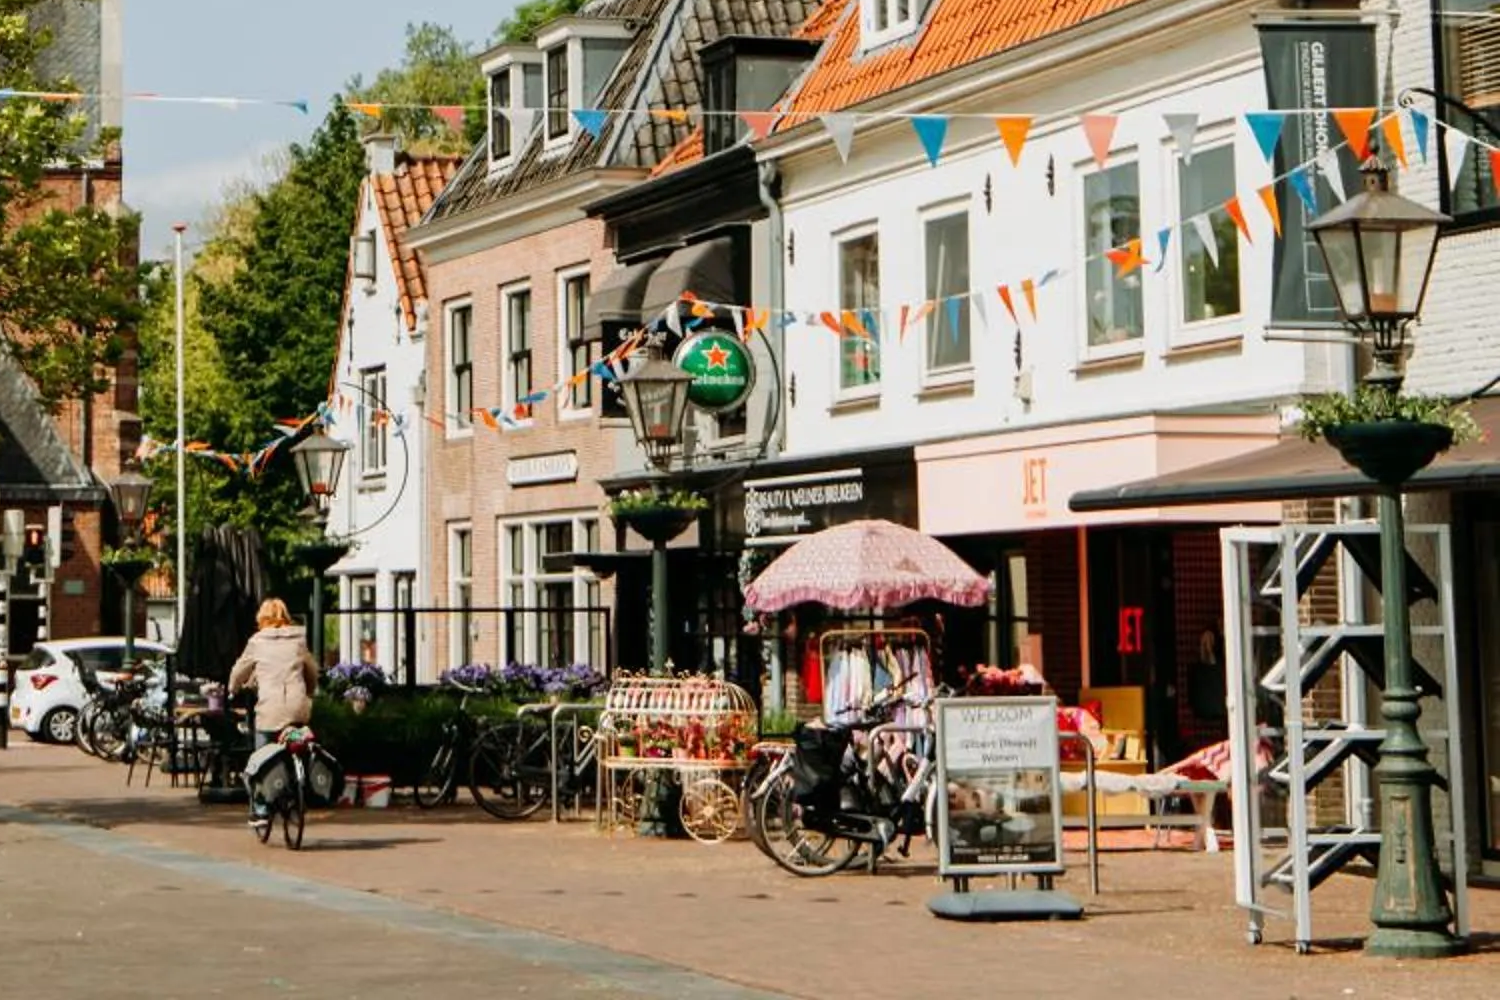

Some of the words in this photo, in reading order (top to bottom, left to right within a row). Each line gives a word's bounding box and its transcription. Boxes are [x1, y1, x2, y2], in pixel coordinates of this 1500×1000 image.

[1311, 41, 1327, 106] GILBERT
[1315, 109, 1329, 175] DHONT
[1023, 458, 1047, 505] JET
[1117, 607, 1144, 652] JET
[961, 706, 1033, 723] WELKOM
